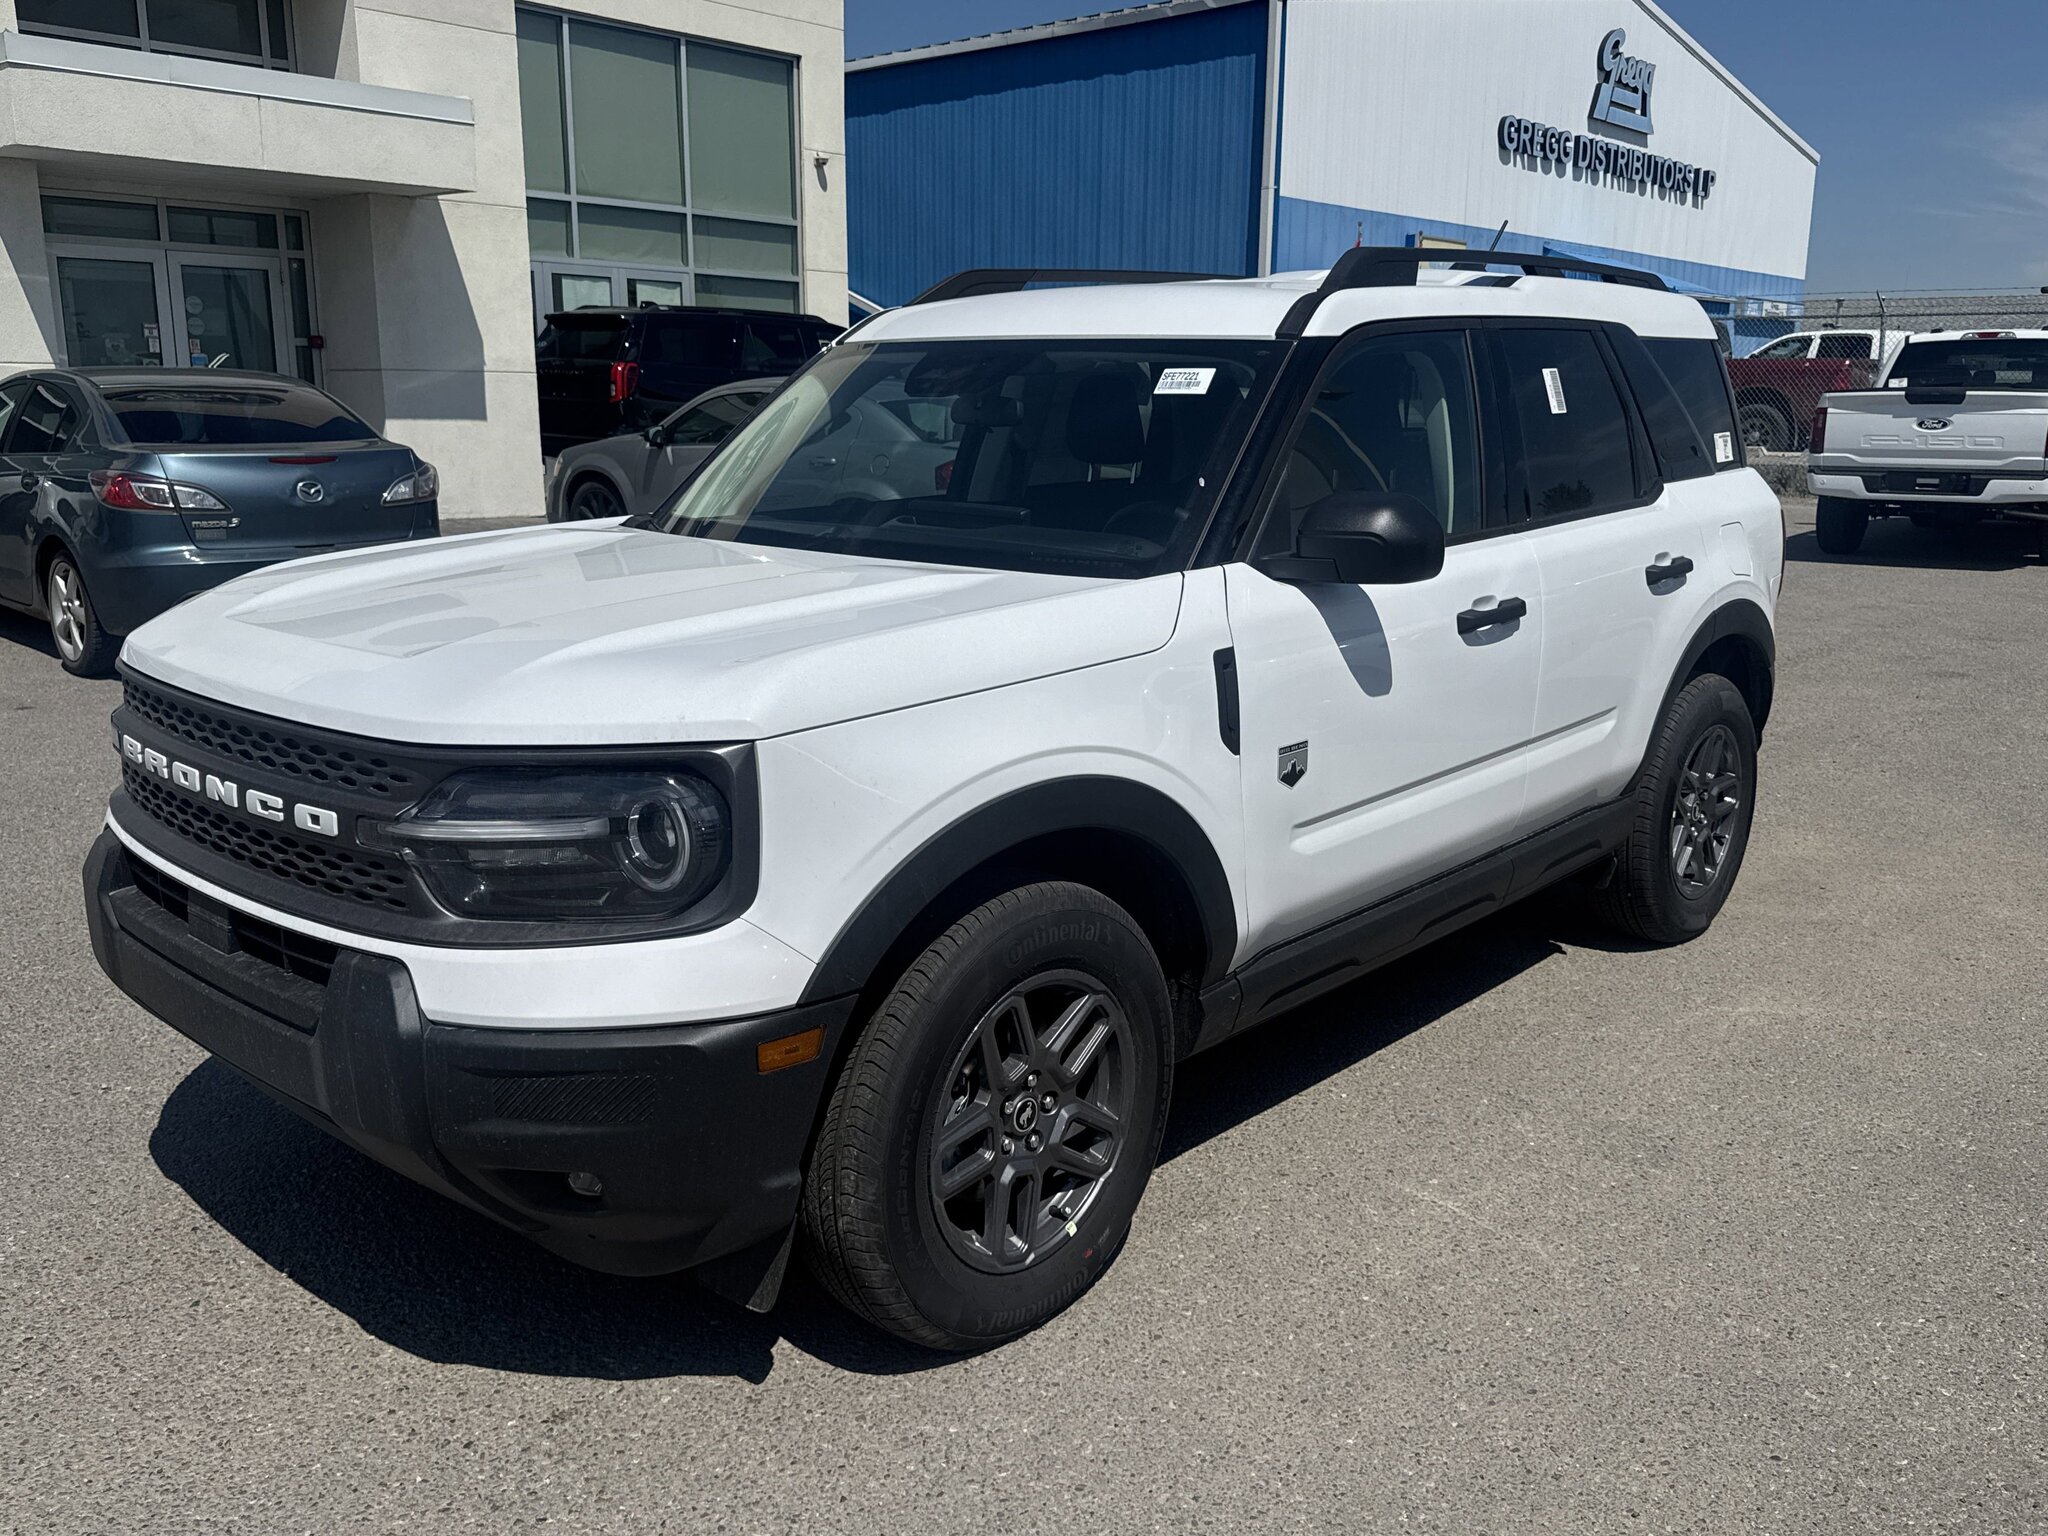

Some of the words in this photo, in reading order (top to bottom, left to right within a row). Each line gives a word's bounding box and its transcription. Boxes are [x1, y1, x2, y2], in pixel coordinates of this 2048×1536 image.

[1597, 27, 1656, 97] Gregg
[1499, 115, 1573, 165] GREGG
[1574, 134, 1694, 194] DISTRIBUTORS
[1694, 167, 1717, 200] LP
[1162, 371, 1199, 381] SFE77221
[1860, 434, 2005, 449] F-150
[1921, 418, 1944, 430] Ford
[122, 734, 339, 837] BRONCO
[1007, 920, 1100, 968] Continental
[988, 1267, 1090, 1332] Continental
